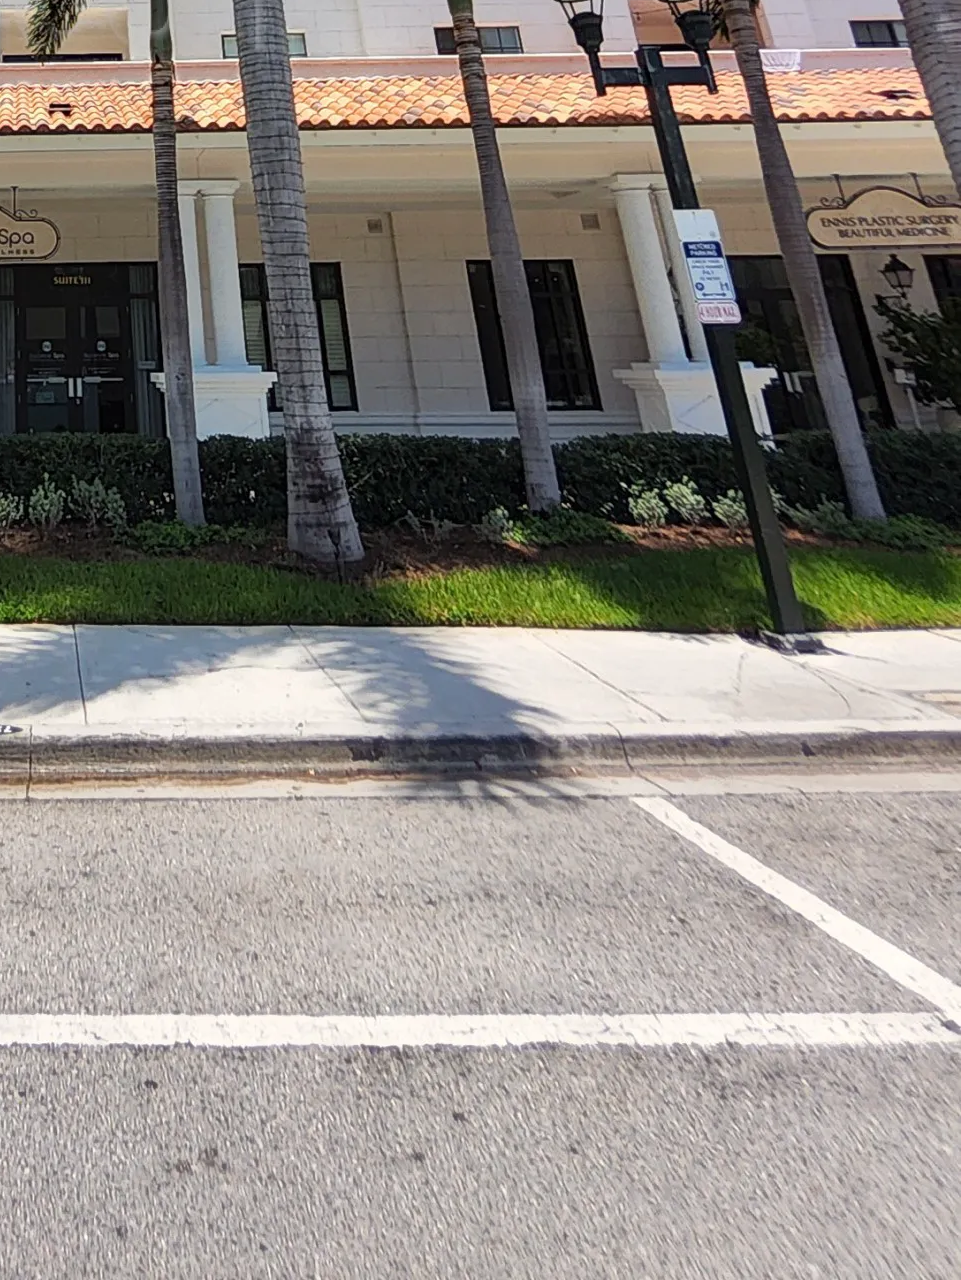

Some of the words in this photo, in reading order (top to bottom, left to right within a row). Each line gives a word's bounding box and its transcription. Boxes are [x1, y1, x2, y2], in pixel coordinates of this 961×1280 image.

[821, 217, 857, 227] ENNIS
[858, 216, 904, 226] PLASTIC
[905, 215, 958, 225] SURGERY
[838, 228, 895, 238] BEAUTIFUL
[896, 227, 951, 237] MEDICINE
[53, 276, 78, 285] SUITE
